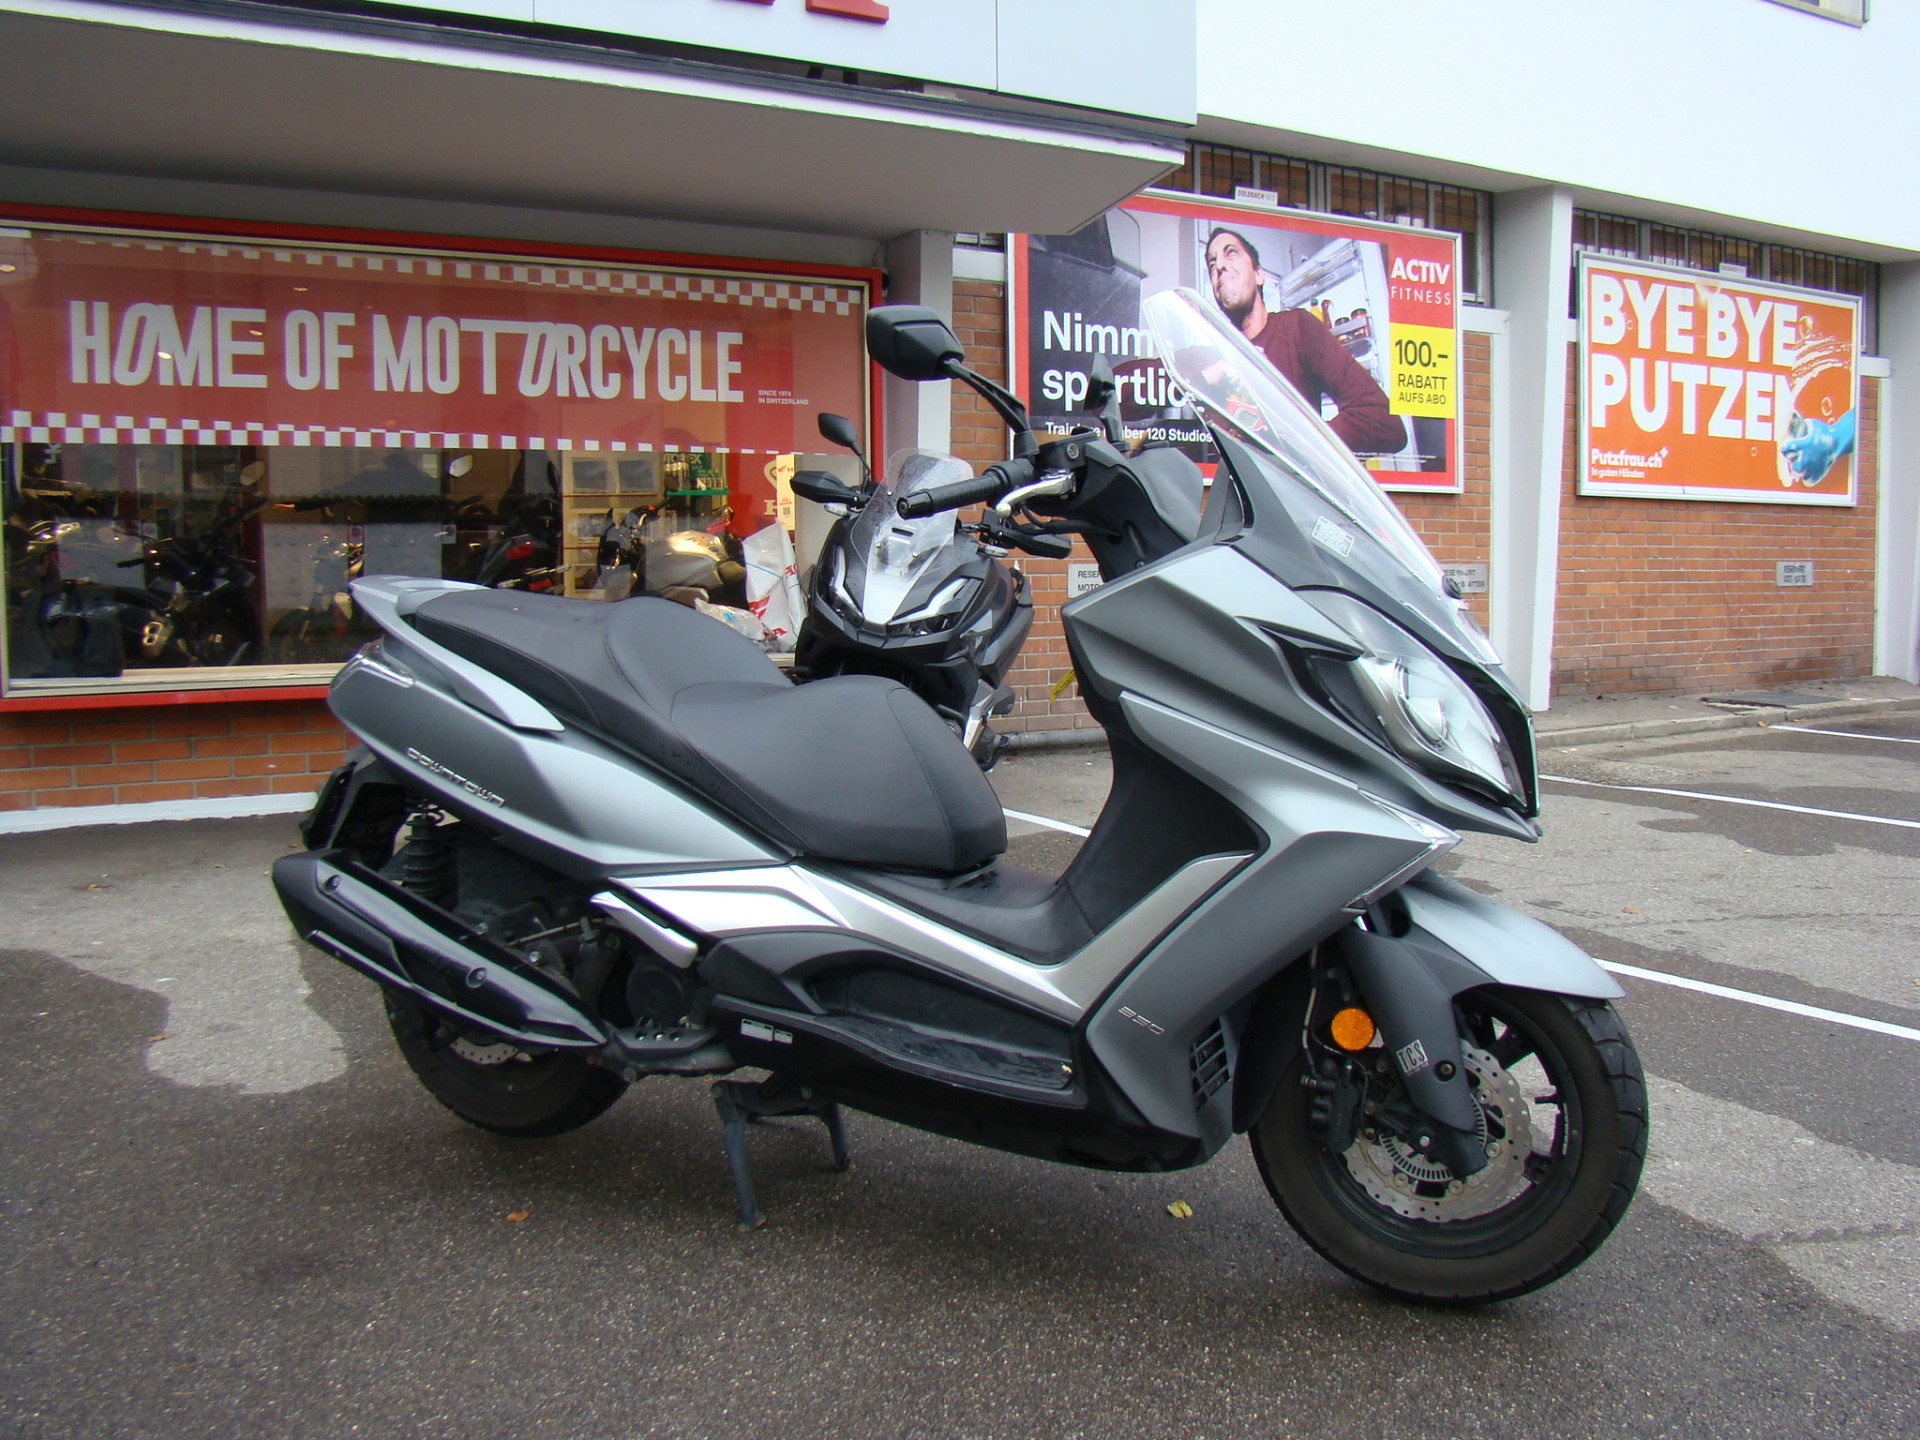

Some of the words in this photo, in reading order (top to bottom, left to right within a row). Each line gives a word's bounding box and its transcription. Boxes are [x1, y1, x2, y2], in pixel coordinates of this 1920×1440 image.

[1391, 257, 1450, 285] ACTIV
[1391, 286, 1451, 306] FITNESS
[1591, 273, 1694, 354] BYE
[1706, 292, 1814, 367] BYE
[69, 300, 268, 388] HOME
[285, 308, 356, 391] OF
[373, 314, 744, 402] MOTORCYCLE
[1397, 373, 1447, 390] RABATT
[758, 389, 777, 397] SINCE
[1398, 391, 1424, 404] AUFS
[1426, 393, 1446, 405] ABO
[1146, 426, 1167, 443] 120
[1168, 428, 1213, 443] Studios
[1591, 447, 1663, 468] Putzfrau.ch
[1598, 468, 1618, 479] guten
[1618, 467, 1645, 479] Händen
[1398, 1042, 1426, 1070] TCS
